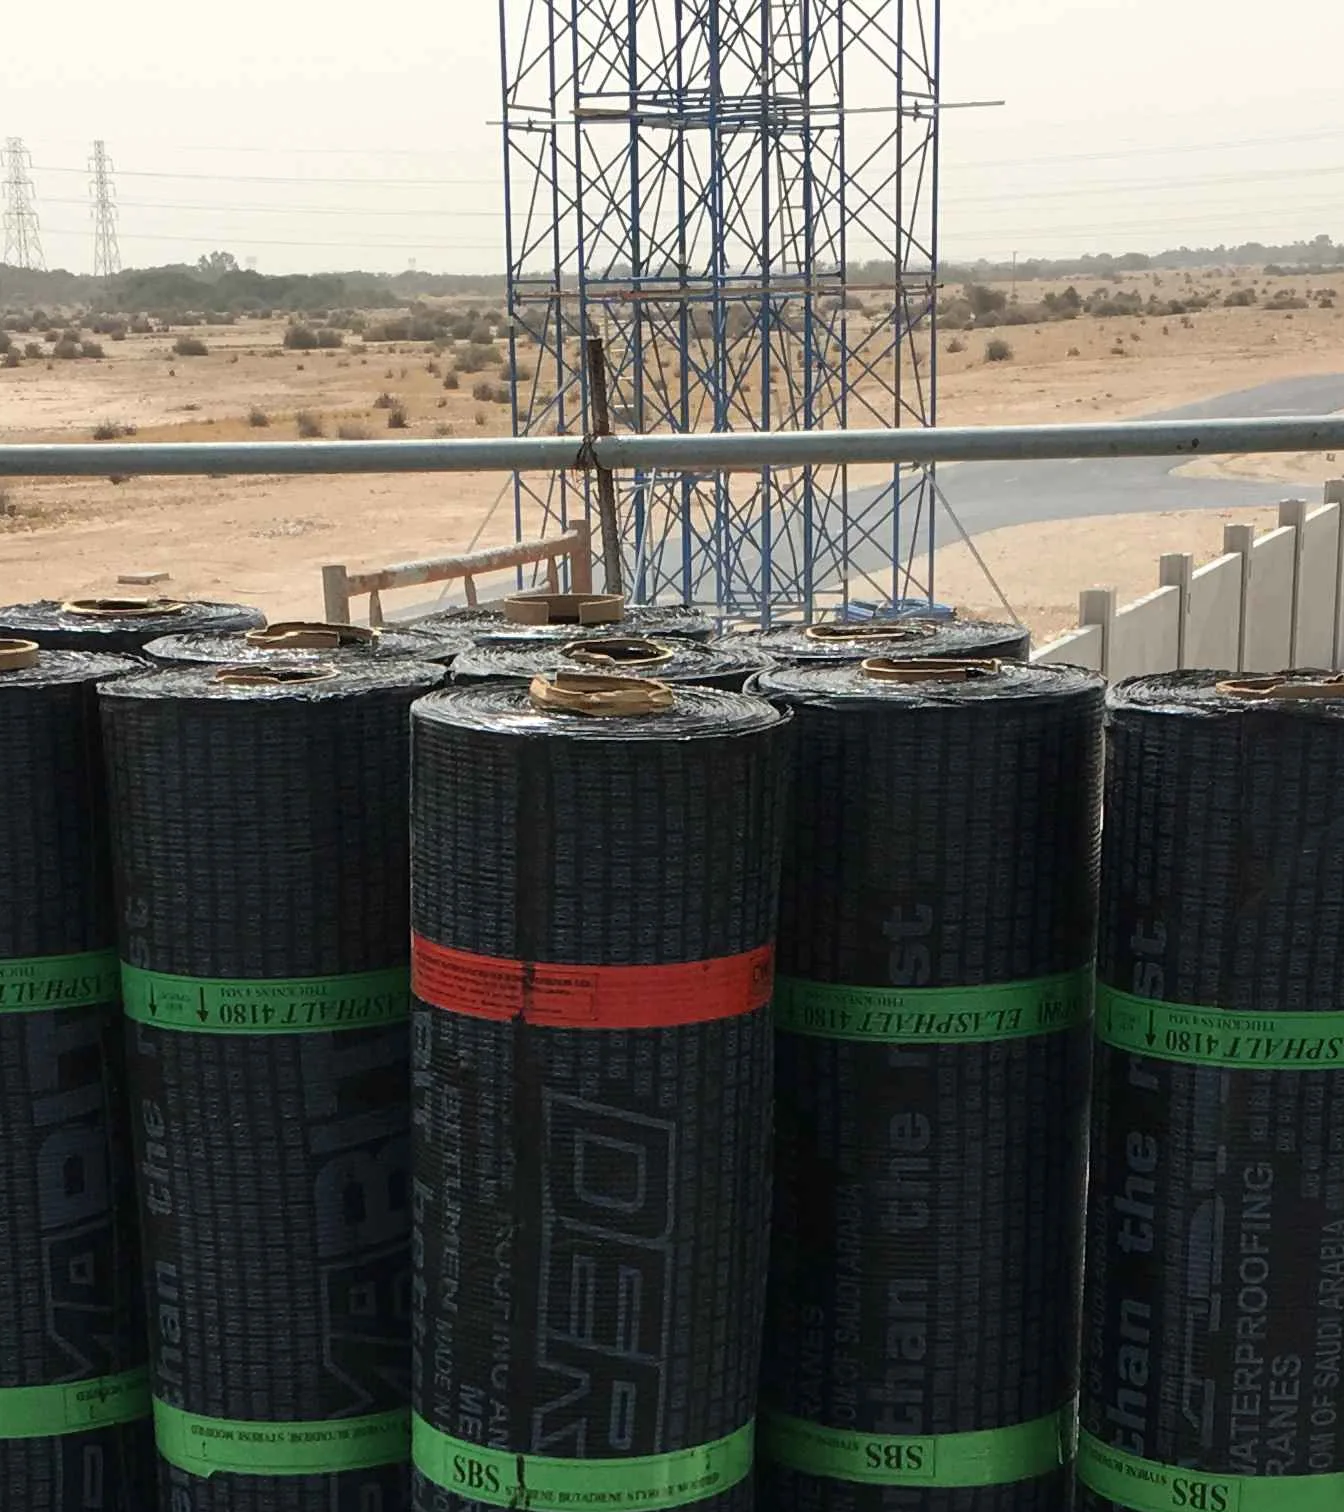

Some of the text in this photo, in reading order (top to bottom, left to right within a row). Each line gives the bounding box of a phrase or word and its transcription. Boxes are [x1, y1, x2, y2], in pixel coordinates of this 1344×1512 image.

[123, 893, 156, 1057] rst
[881, 902, 934, 1067] rst
[1126, 917, 1168, 1089] rst
[218, 1002, 275, 1024] 4180
[802, 1005, 851, 1030] 4180
[857, 1007, 1023, 1034] ELASPHALT
[1163, 1028, 1218, 1053] 4180
[139, 1095, 174, 1216] the
[874, 1109, 933, 1232] the
[1113, 1130, 1160, 1252] the
[836, 1180, 864, 1270] ARABIA
[834, 1273, 860, 1343] SAUDI
[431, 1317, 453, 1390] MADE
[834, 1349, 859, 1377] OF
[866, 1277, 930, 1435] than
[1107, 1295, 1152, 1455] than
[1312, 1315, 1343, 1388] SAUDI
[1308, 1394, 1338, 1424] OF
[452, 1454, 500, 1493] SBS
[863, 1441, 923, 1470] SBS
[1169, 1476, 1228, 1512] SBS
